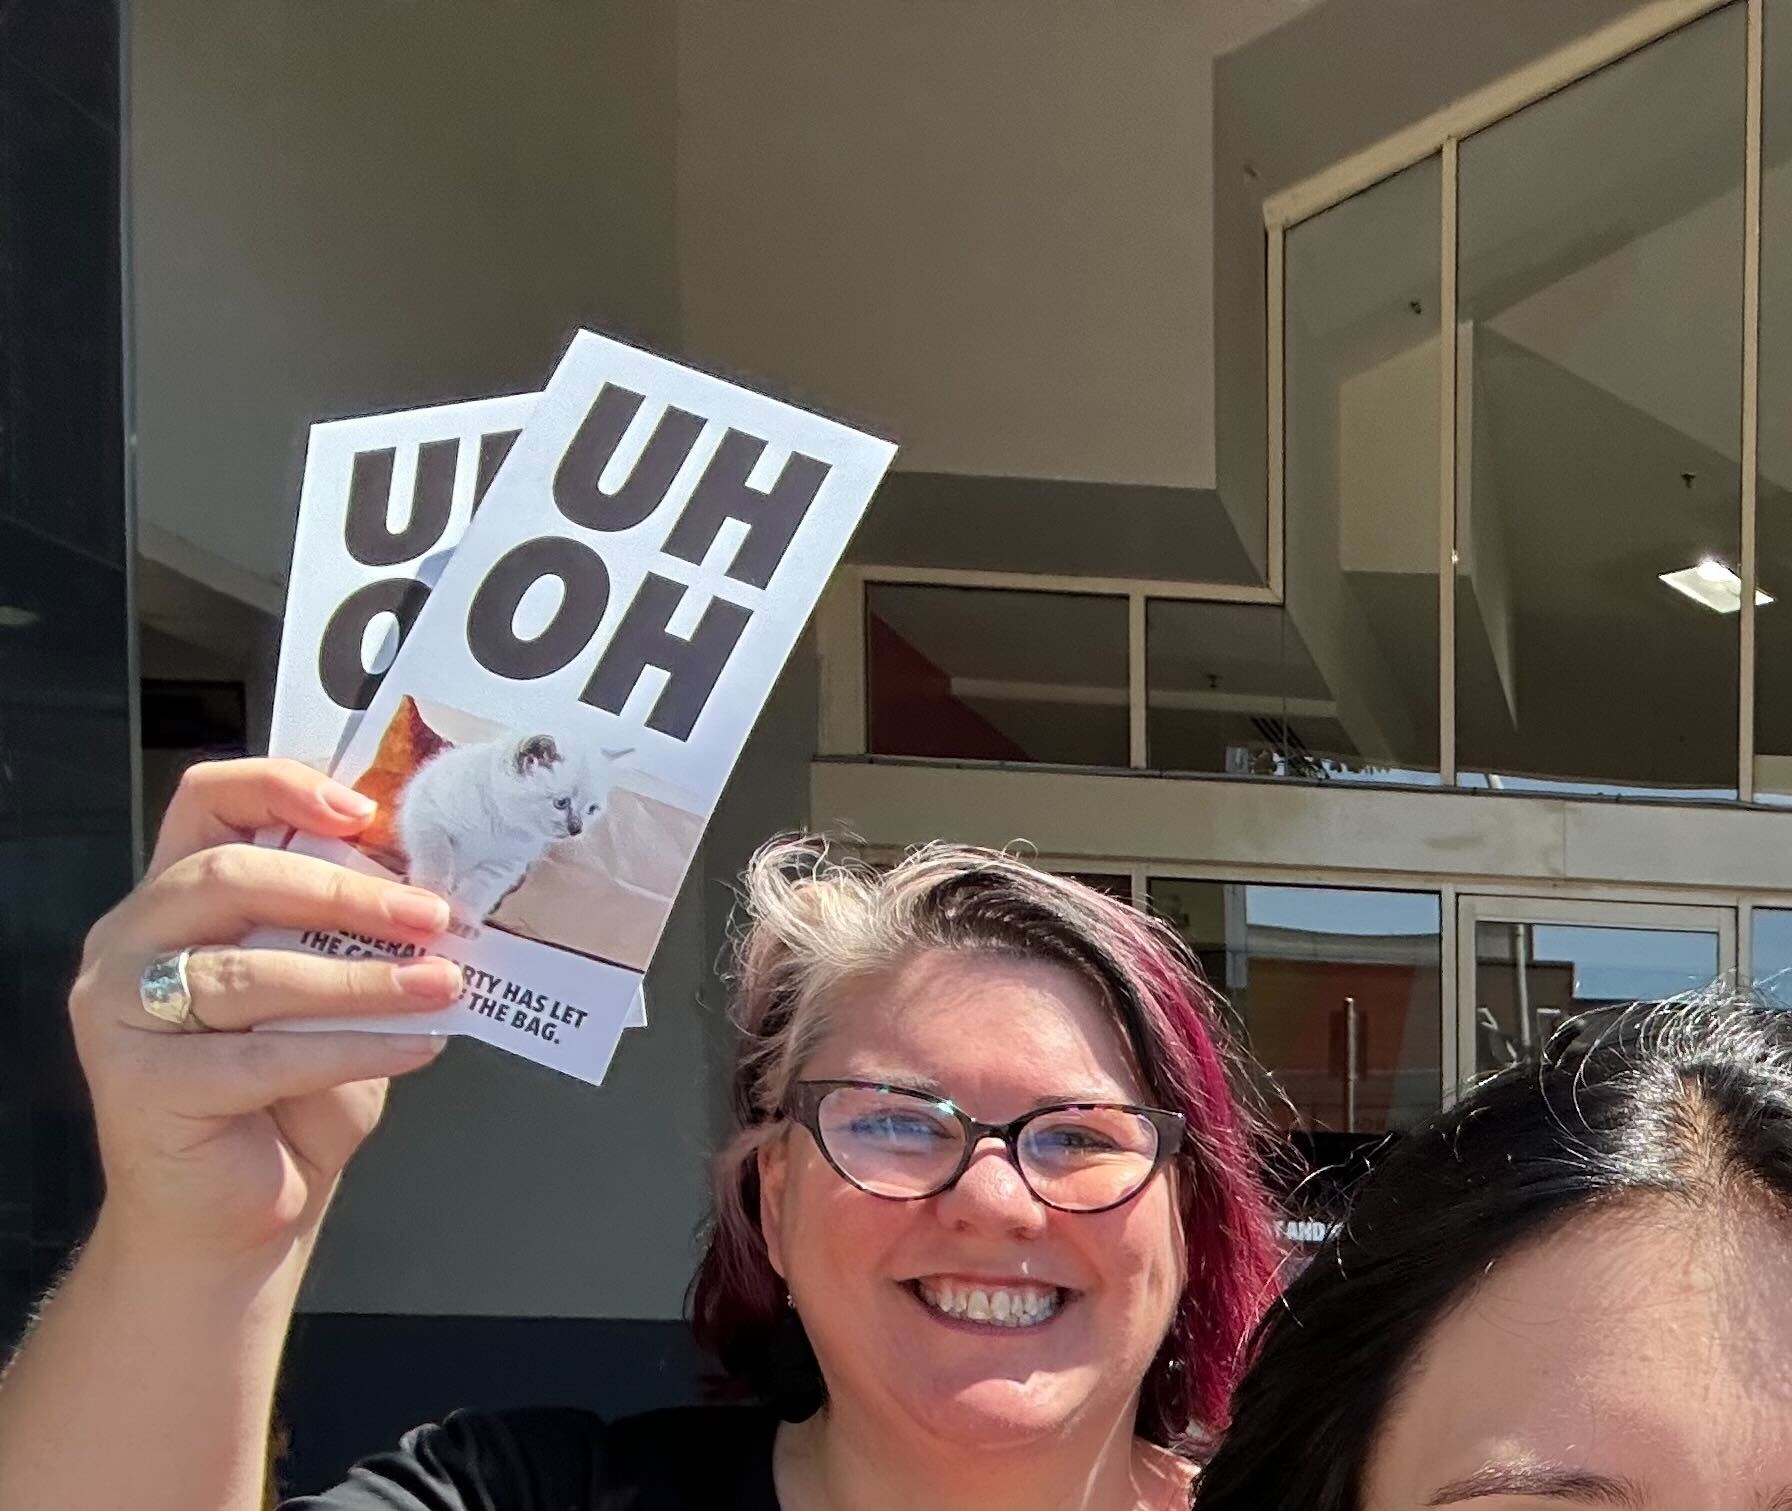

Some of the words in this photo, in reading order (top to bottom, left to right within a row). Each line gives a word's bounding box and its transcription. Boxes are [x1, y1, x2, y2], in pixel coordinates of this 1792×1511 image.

[552, 381, 834, 591] UH
[318, 577, 434, 711] O
[466, 535, 755, 742] OH
[300, 929, 343, 955] THE
[468, 992, 510, 1022] THE
[510, 1009, 560, 1045] BAG.
[452, 958, 502, 994] RTY
[502, 981, 549, 1013] HAS
[549, 1000, 588, 1029] LET
